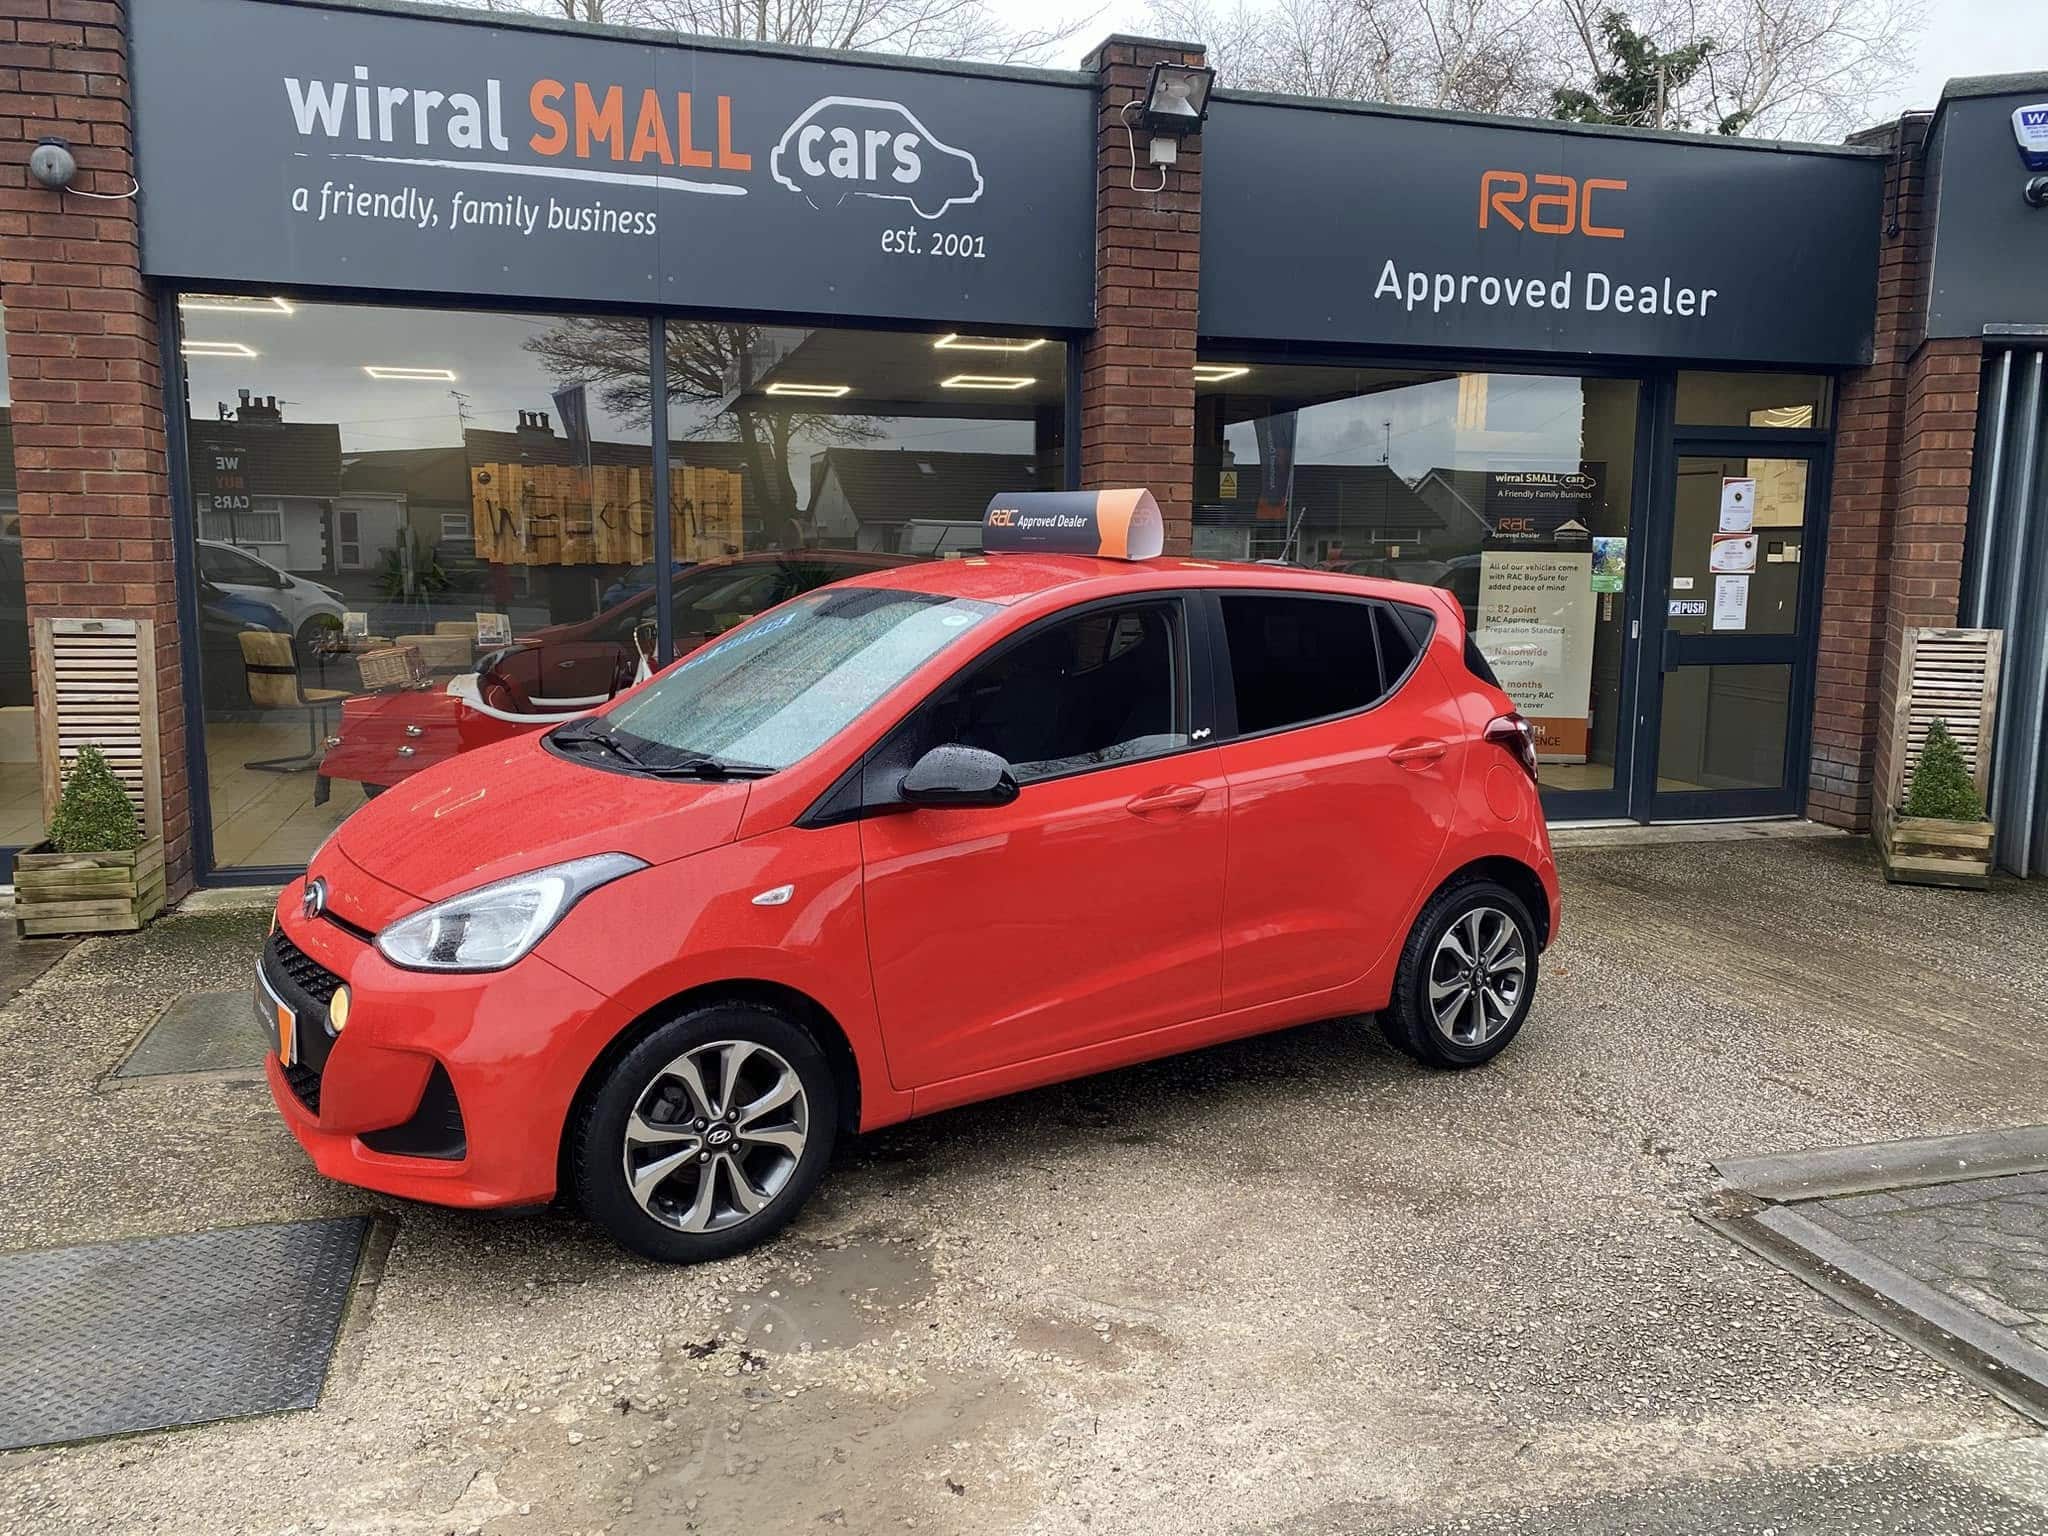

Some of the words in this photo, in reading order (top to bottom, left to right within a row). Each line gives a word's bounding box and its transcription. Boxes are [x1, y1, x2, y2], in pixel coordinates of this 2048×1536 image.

[2028, 112, 2048, 124] W
[284, 64, 509, 153] wirral
[528, 78, 752, 172] SMALL
[798, 124, 922, 184] cars
[291, 187, 309, 214] a
[317, 181, 439, 229] friendly,
[449, 190, 540, 235] family
[547, 202, 657, 237] business
[881, 225, 922, 255] est.
[930, 232, 987, 258] 2001
[1373, 259, 1572, 313] Approved
[1585, 272, 1718, 317] Dealer
[1495, 472, 1524, 482] wirral
[1526, 473, 1558, 483] SMALL
[1565, 475, 1585, 483] cars
[1504, 489, 1534, 499] Friendly
[1535, 490, 1559, 499] Family
[1561, 490, 1592, 499] Business
[1017, 514, 1056, 530] Approved
[1057, 514, 1088, 529] Dealer
[1491, 531, 1520, 539] Approved
[1521, 531, 1540, 539] Dealer
[1526, 563, 1556, 571] vehicles
[1524, 574, 1555, 582] BuySure
[1488, 583, 1511, 591] added
[1512, 584, 1536, 592] peace
[1497, 604, 1509, 613] 82
[1512, 605, 1537, 615] point
[1681, 602, 1704, 614] PUSH
[1502, 616, 1539, 624] Approved
[1531, 626, 1565, 634] Standard
[1500, 659, 1534, 667] warranty
[1507, 680, 1543, 689] months
[1506, 692, 1536, 700] mentary
[1538, 691, 1554, 699] RAC
[1532, 725, 1546, 735] TH
